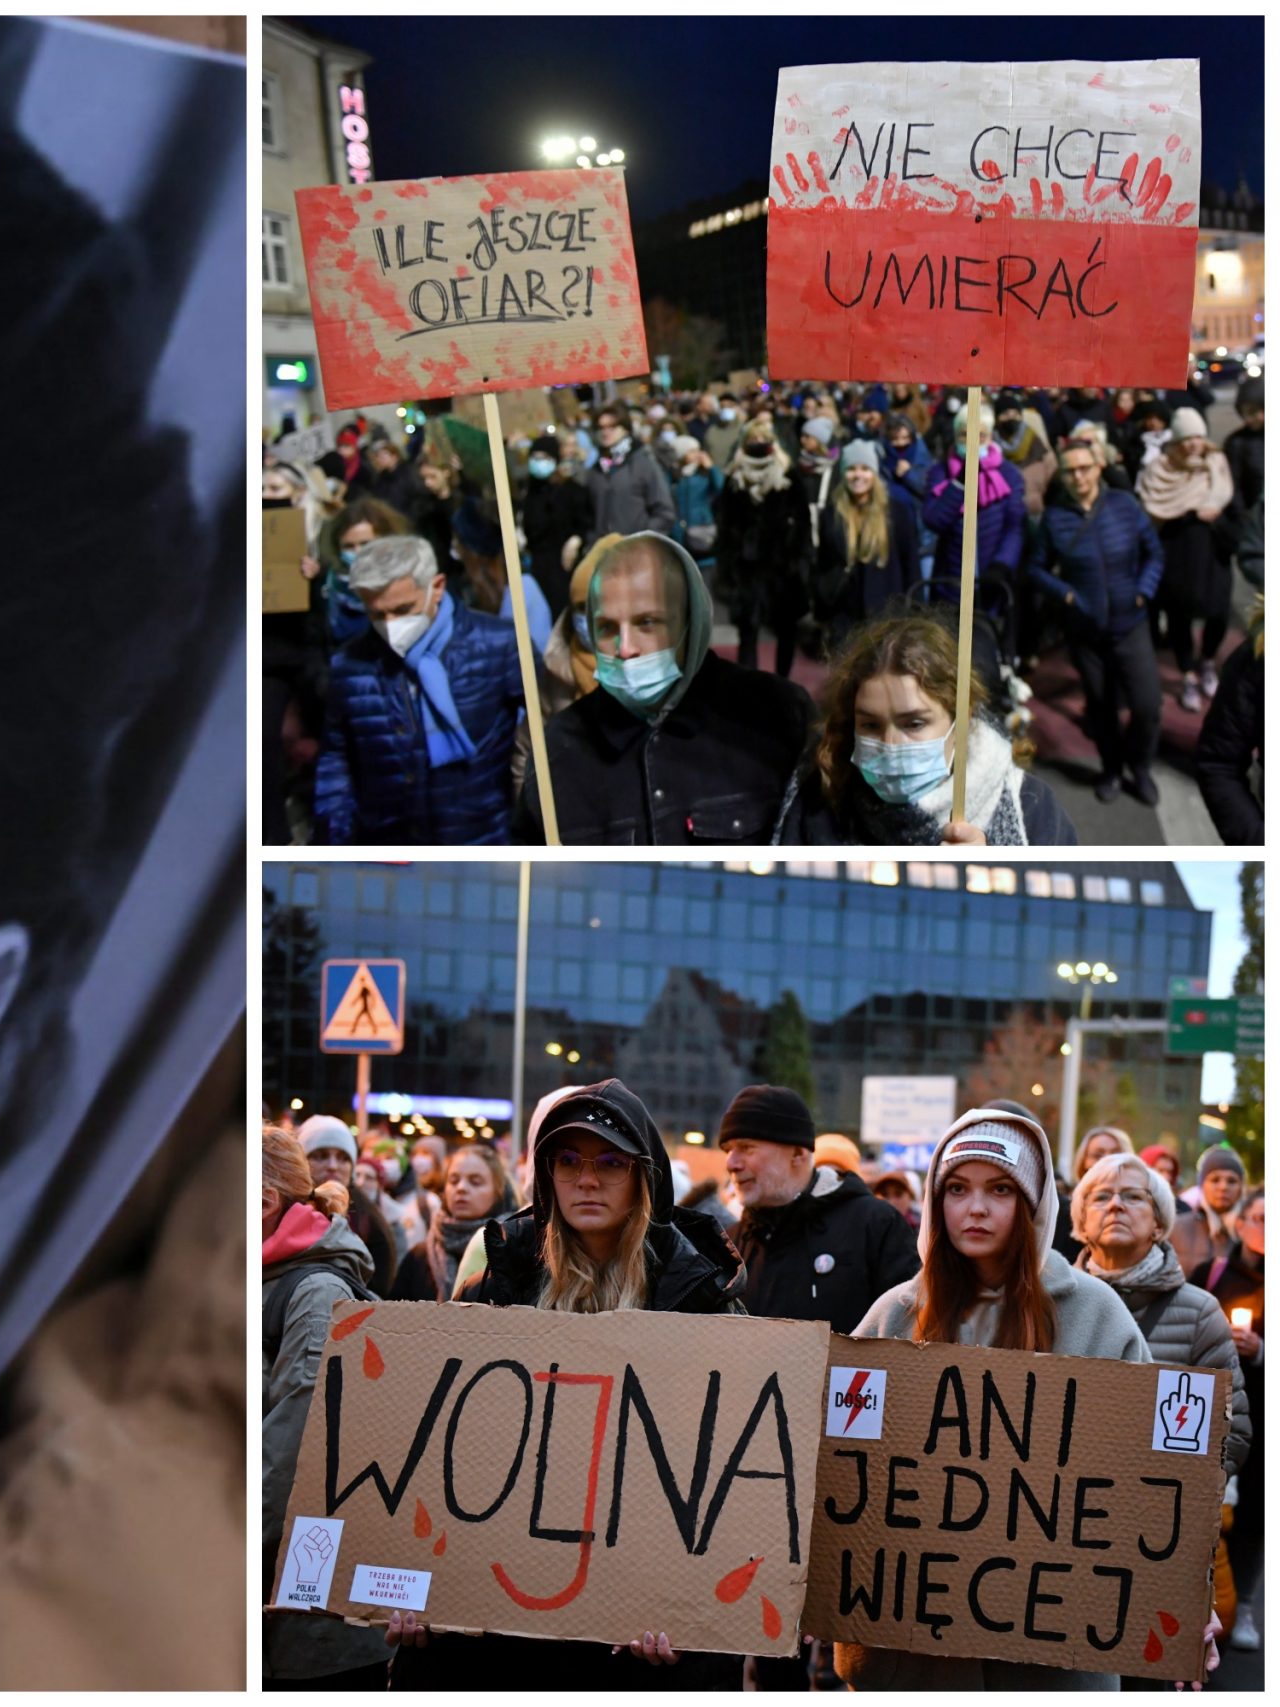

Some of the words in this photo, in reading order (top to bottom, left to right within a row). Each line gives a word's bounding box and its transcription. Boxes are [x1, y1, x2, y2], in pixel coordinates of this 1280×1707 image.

[828, 121, 935, 182] NIE
[969, 124, 1137, 207] CHCĘ
[371, 219, 449, 276] ILE
[465, 206, 599, 271] JESZCZE
[409, 264, 594, 326] OFIAR?!
[825, 237, 1119, 321] UMIERAĆ
[834, 1387, 877, 1411] DOŚĆ!
[923, 1364, 1077, 1468] ANI
[823, 1449, 1183, 1562] JEDNEJ
[295, 1583, 317, 1593] POLKA
[368, 1571, 396, 1581] TRZEBA
[398, 1574, 417, 1583] BYŁO
[376, 1581, 390, 1589] NAS
[393, 1583, 405, 1591] NIE
[838, 1547, 1134, 1652] WIĘCEJ
